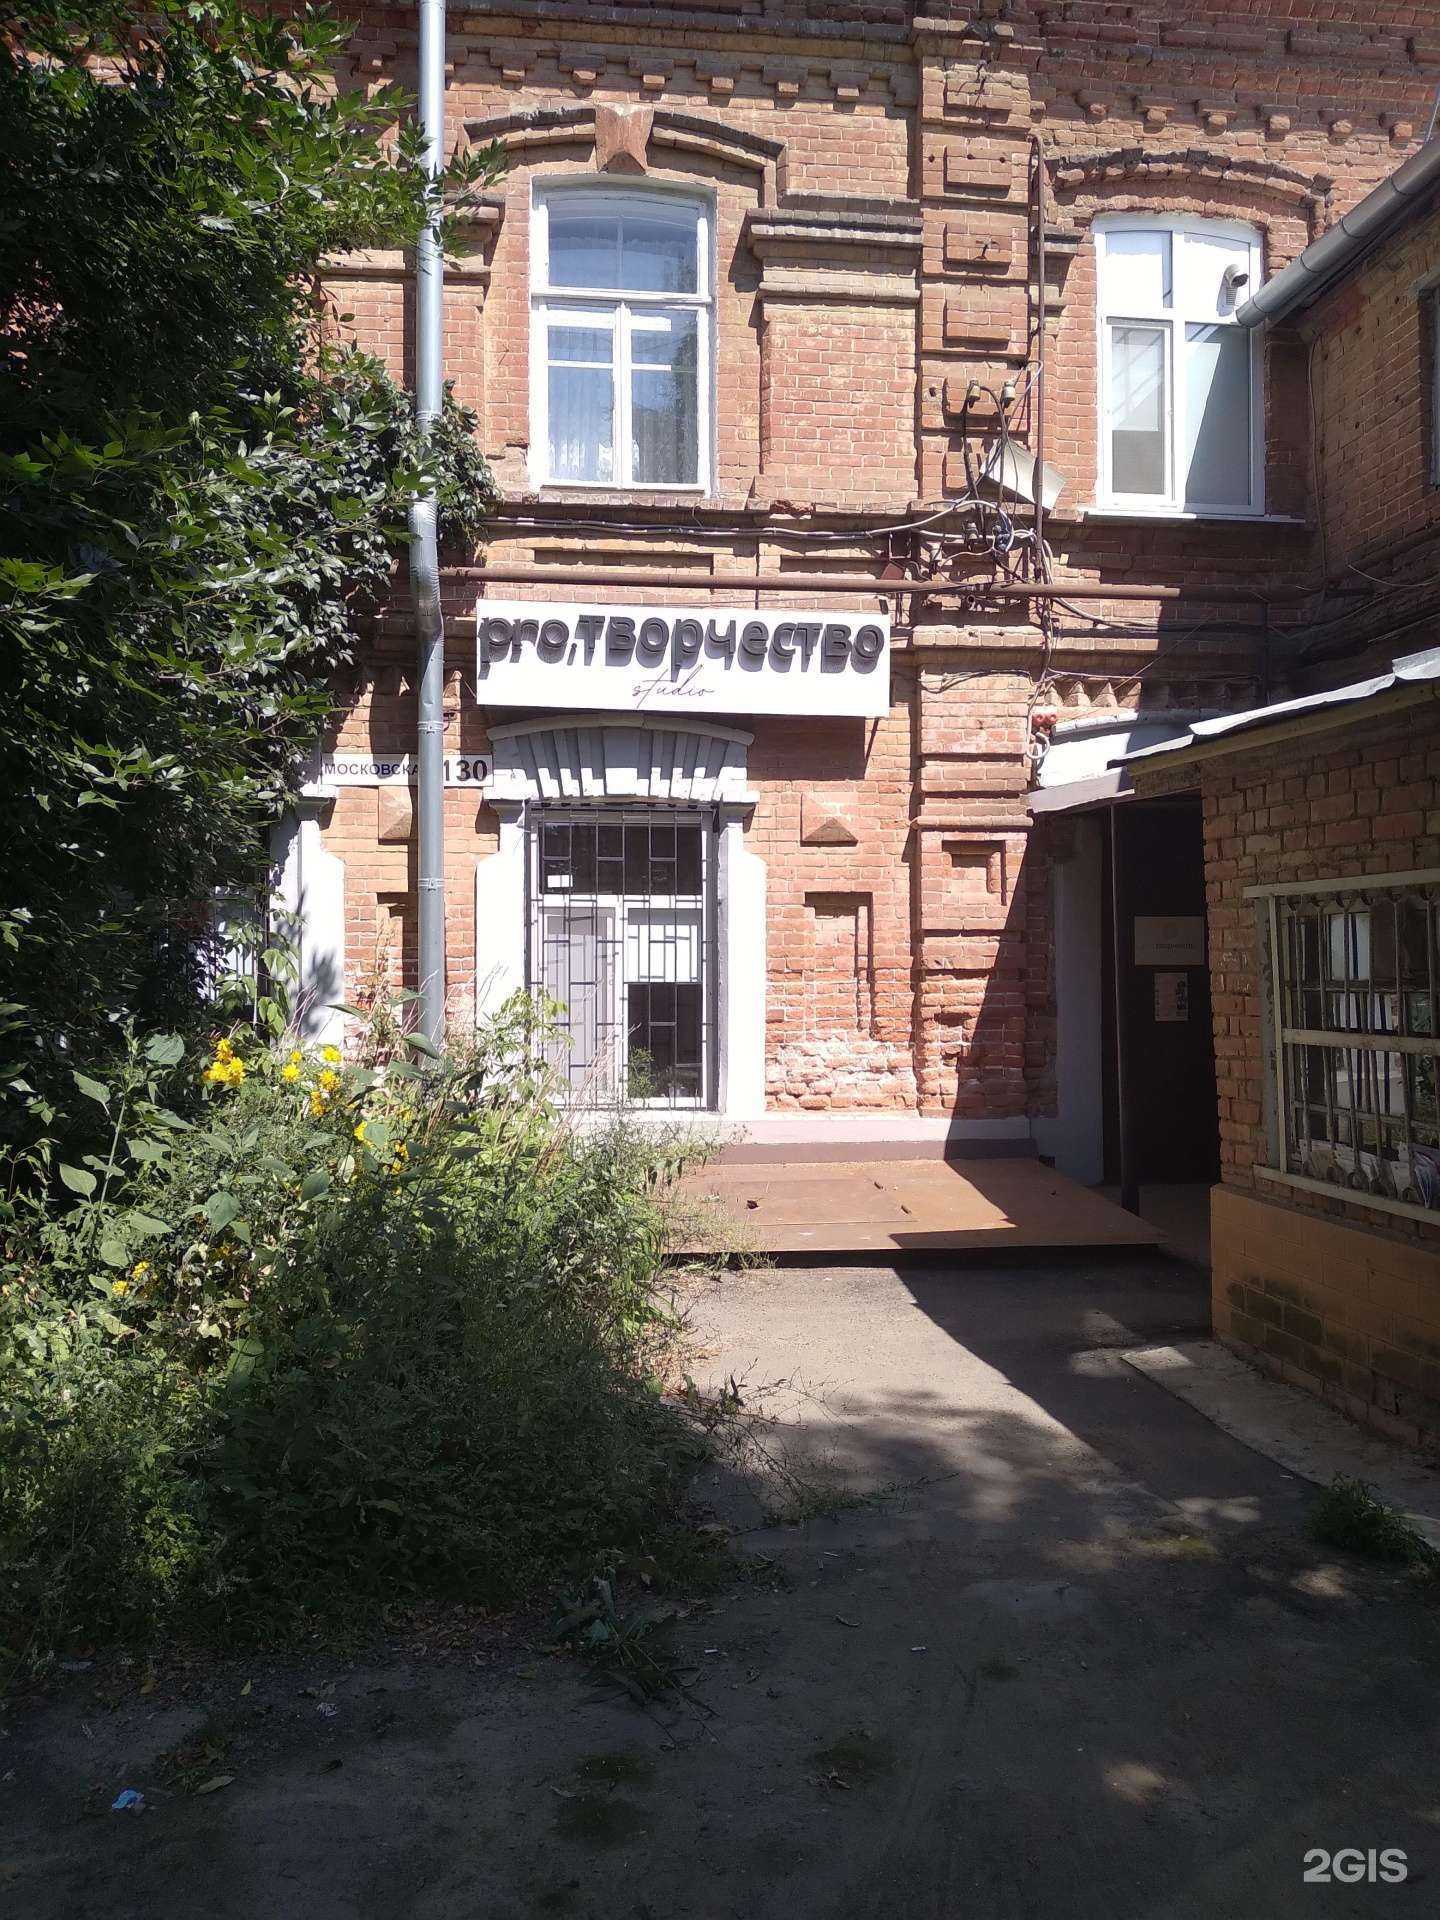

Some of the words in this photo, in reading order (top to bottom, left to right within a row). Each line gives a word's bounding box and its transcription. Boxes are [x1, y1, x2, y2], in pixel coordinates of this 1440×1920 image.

[632, 664, 715, 709] studio
[324, 763, 418, 776] МОСКОВСКА
[443, 759, 488, 782] 130
